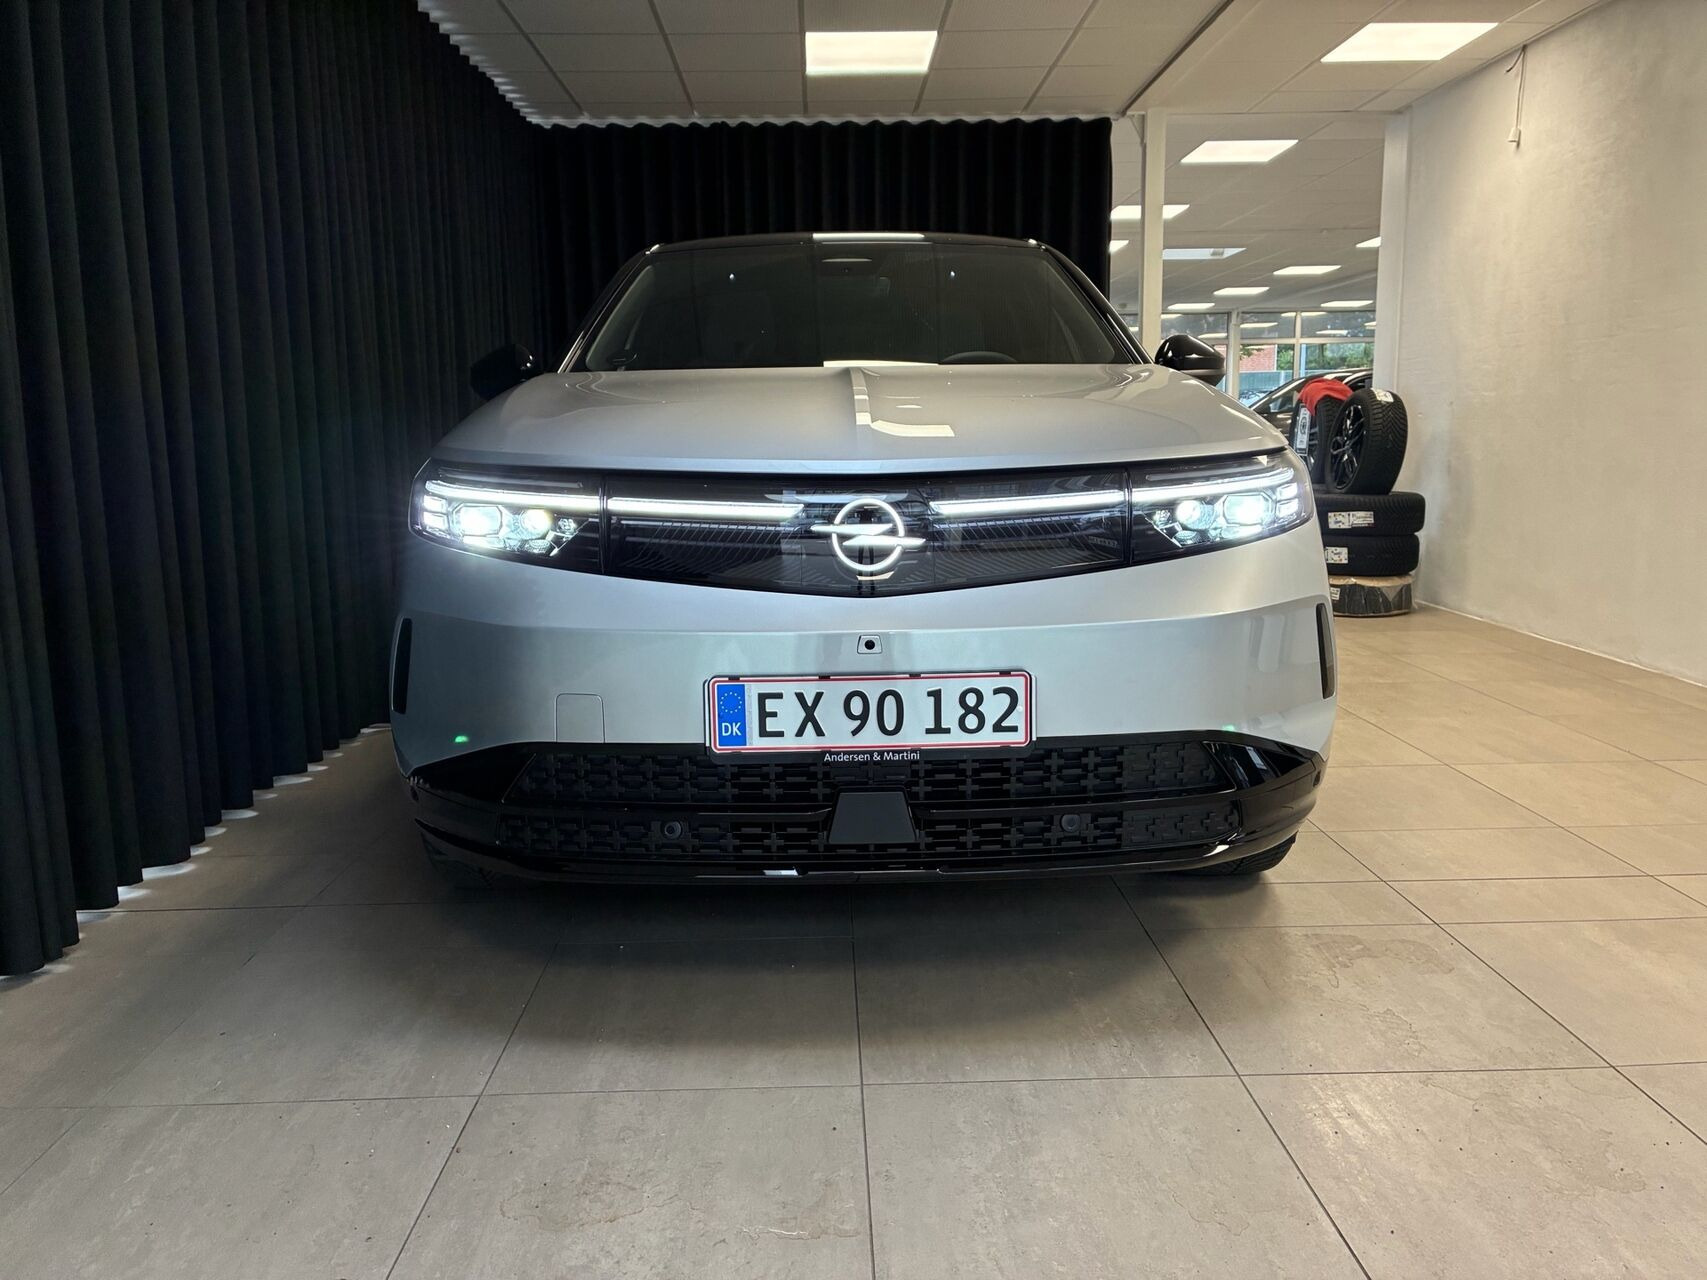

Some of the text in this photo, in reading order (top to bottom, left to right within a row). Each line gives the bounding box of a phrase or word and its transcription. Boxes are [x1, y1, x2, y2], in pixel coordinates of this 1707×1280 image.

[757, 686, 1020, 738] EX 90 182
[721, 722, 742, 736] DK
[823, 751, 920, 762] Andersen & Martini
